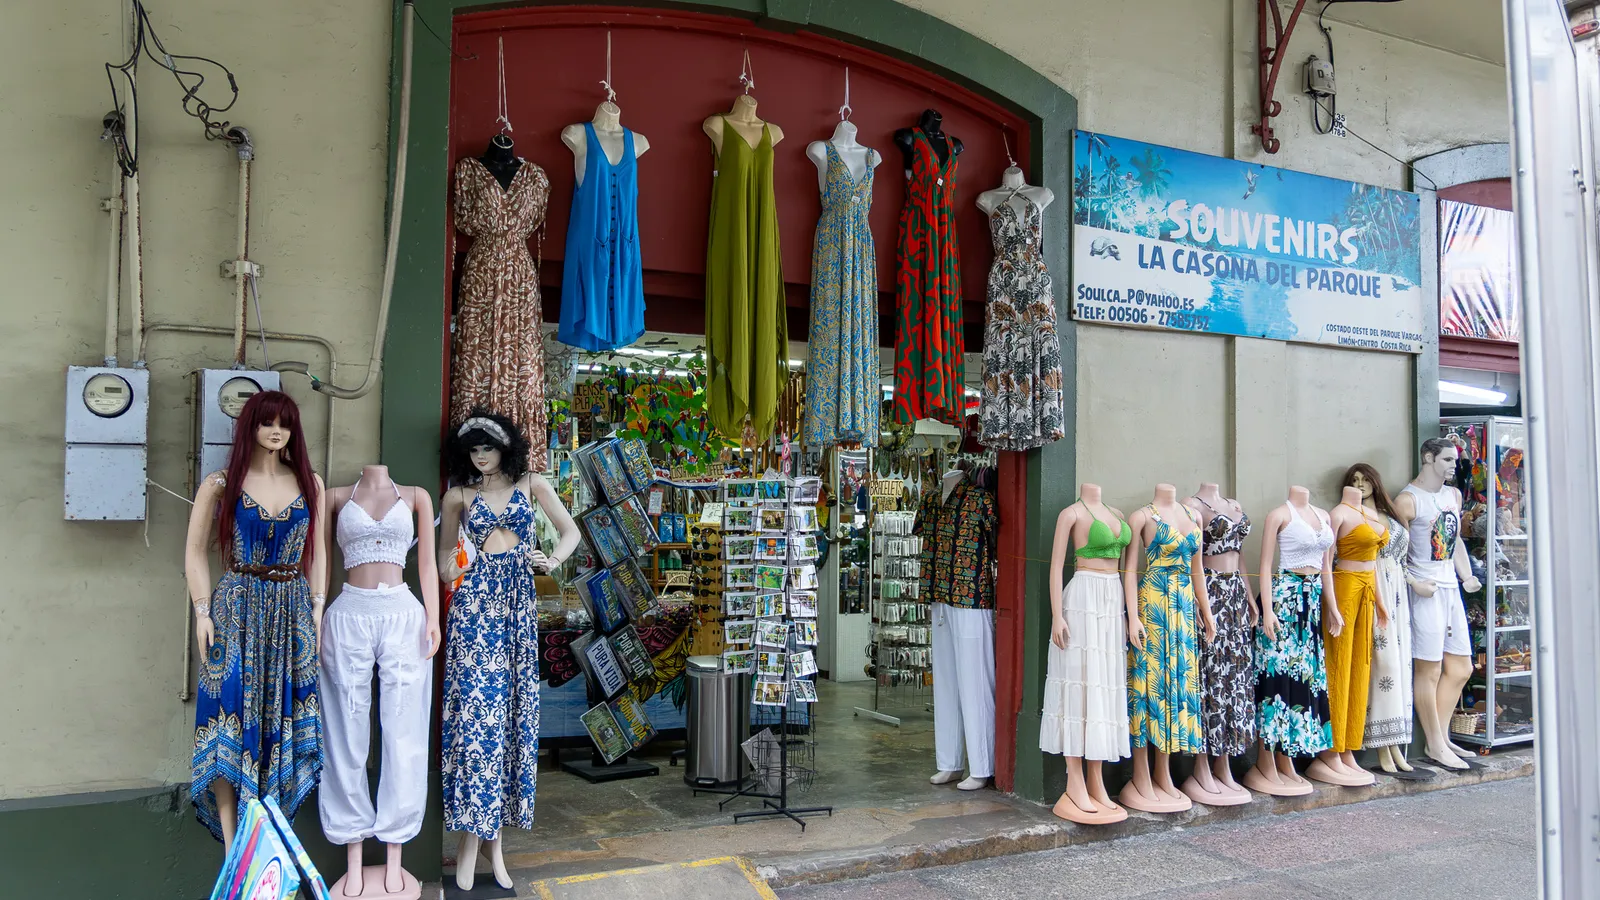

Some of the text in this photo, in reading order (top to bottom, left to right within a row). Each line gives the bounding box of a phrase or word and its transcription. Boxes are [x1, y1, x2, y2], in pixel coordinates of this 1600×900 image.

[1166, 199, 1359, 265] SOUVENIRS
[1138, 244, 1382, 299] LA CASONA DEL PARQUE
[1108, 306, 1148, 324] 00506
[1326, 324, 1423, 342] COSTADO OESTE DEL PARQUE VARGAS
[1380, 340, 1398, 350] COSTA
[1398, 342, 1412, 352] RICA
[869, 480, 903, 496] BRACELETS
[591, 643, 621, 692] PURA VIDA
[615, 631, 636, 656] PURA
[627, 654, 648, 678] VIDA
[617, 697, 647, 741] PURA VIDA
